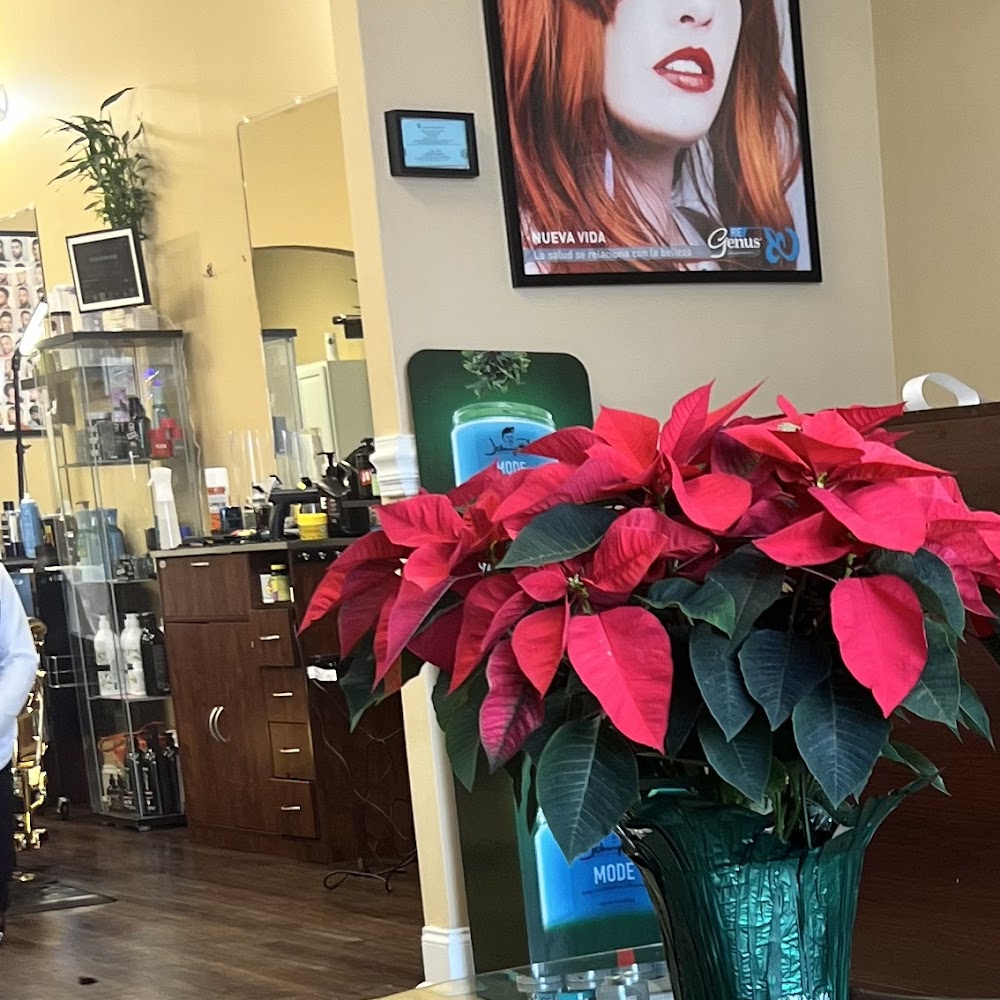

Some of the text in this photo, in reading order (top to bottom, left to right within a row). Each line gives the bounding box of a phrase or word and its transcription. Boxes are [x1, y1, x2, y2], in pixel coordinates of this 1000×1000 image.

[531, 230, 607, 245] NUEVA VIDA
[534, 246, 692, 260] La salud se relaciona con la belleza
[593, 861, 636, 885] MODE
